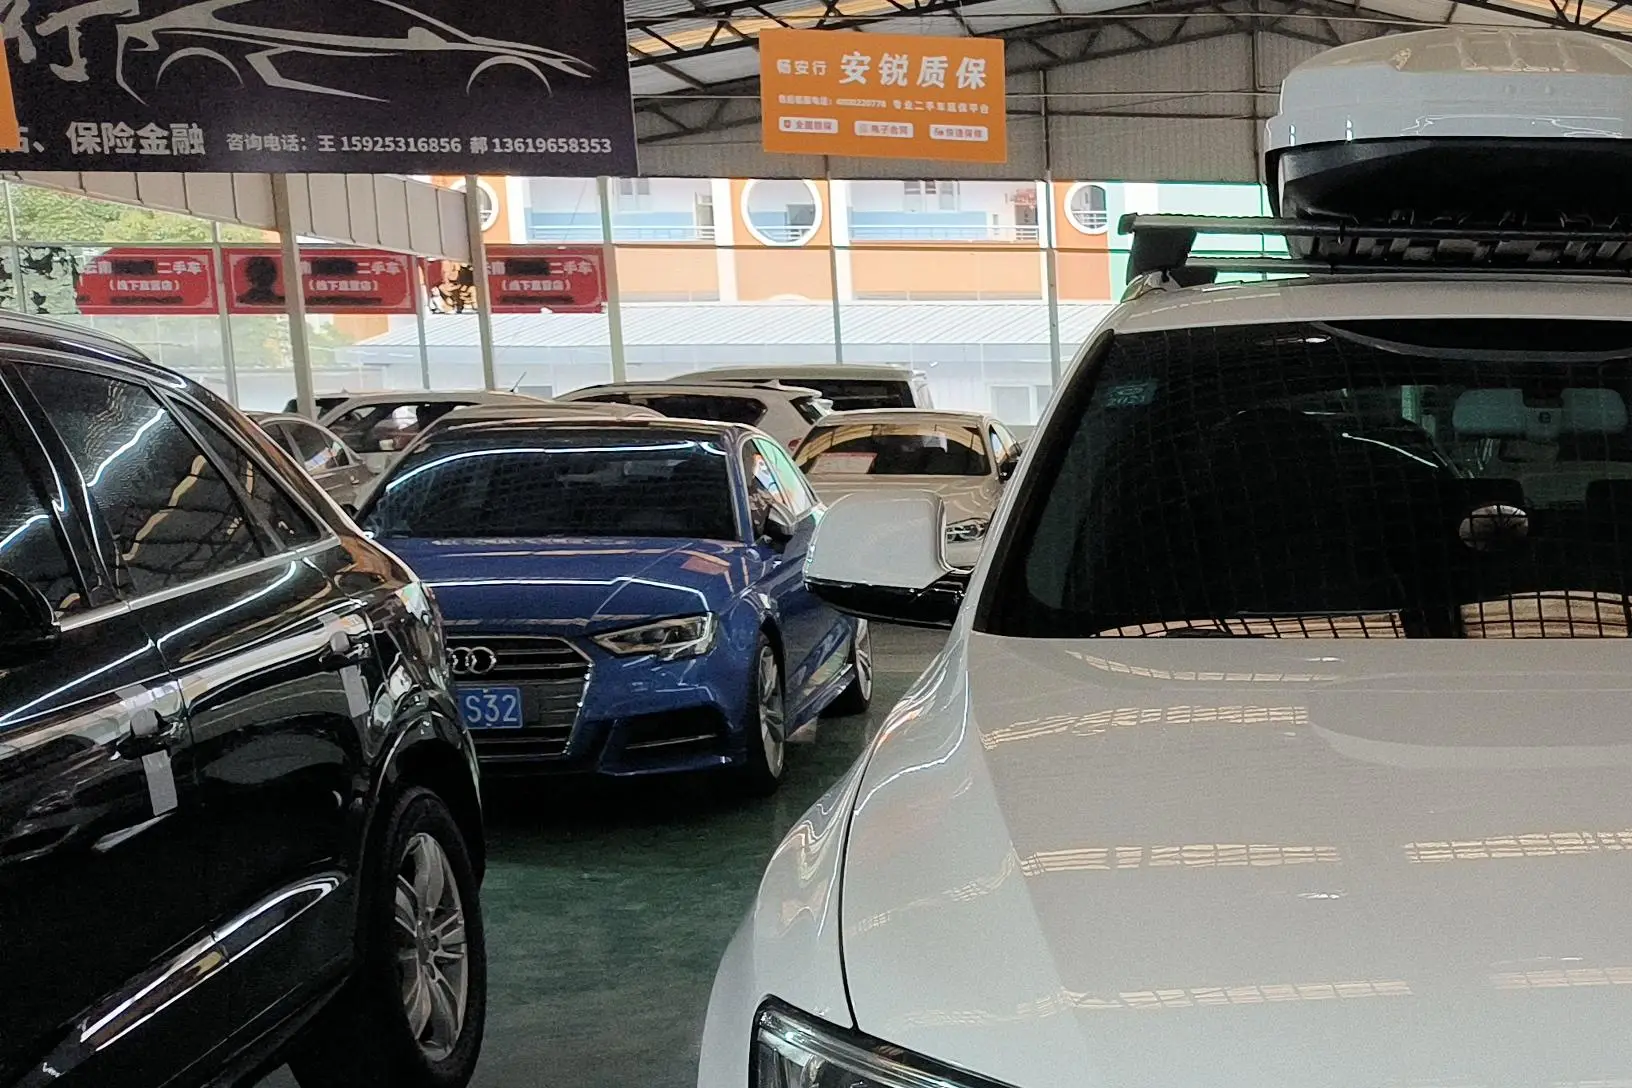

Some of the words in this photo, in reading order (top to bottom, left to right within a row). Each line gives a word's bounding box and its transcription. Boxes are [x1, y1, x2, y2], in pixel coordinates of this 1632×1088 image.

[838, 51, 987, 90] 安锐质保
[4, 121, 206, 156] 、保险金融
[226, 133, 307, 152] 咨询电话：
[316, 134, 337, 152] 王
[341, 135, 462, 153] 15925316856
[492, 137, 612, 153] 13619658353
[157, 261, 202, 275] 二手车
[357, 261, 401, 275] 二手车
[550, 260, 592, 275] 二手车
[465, 694, 518, 722] S32
